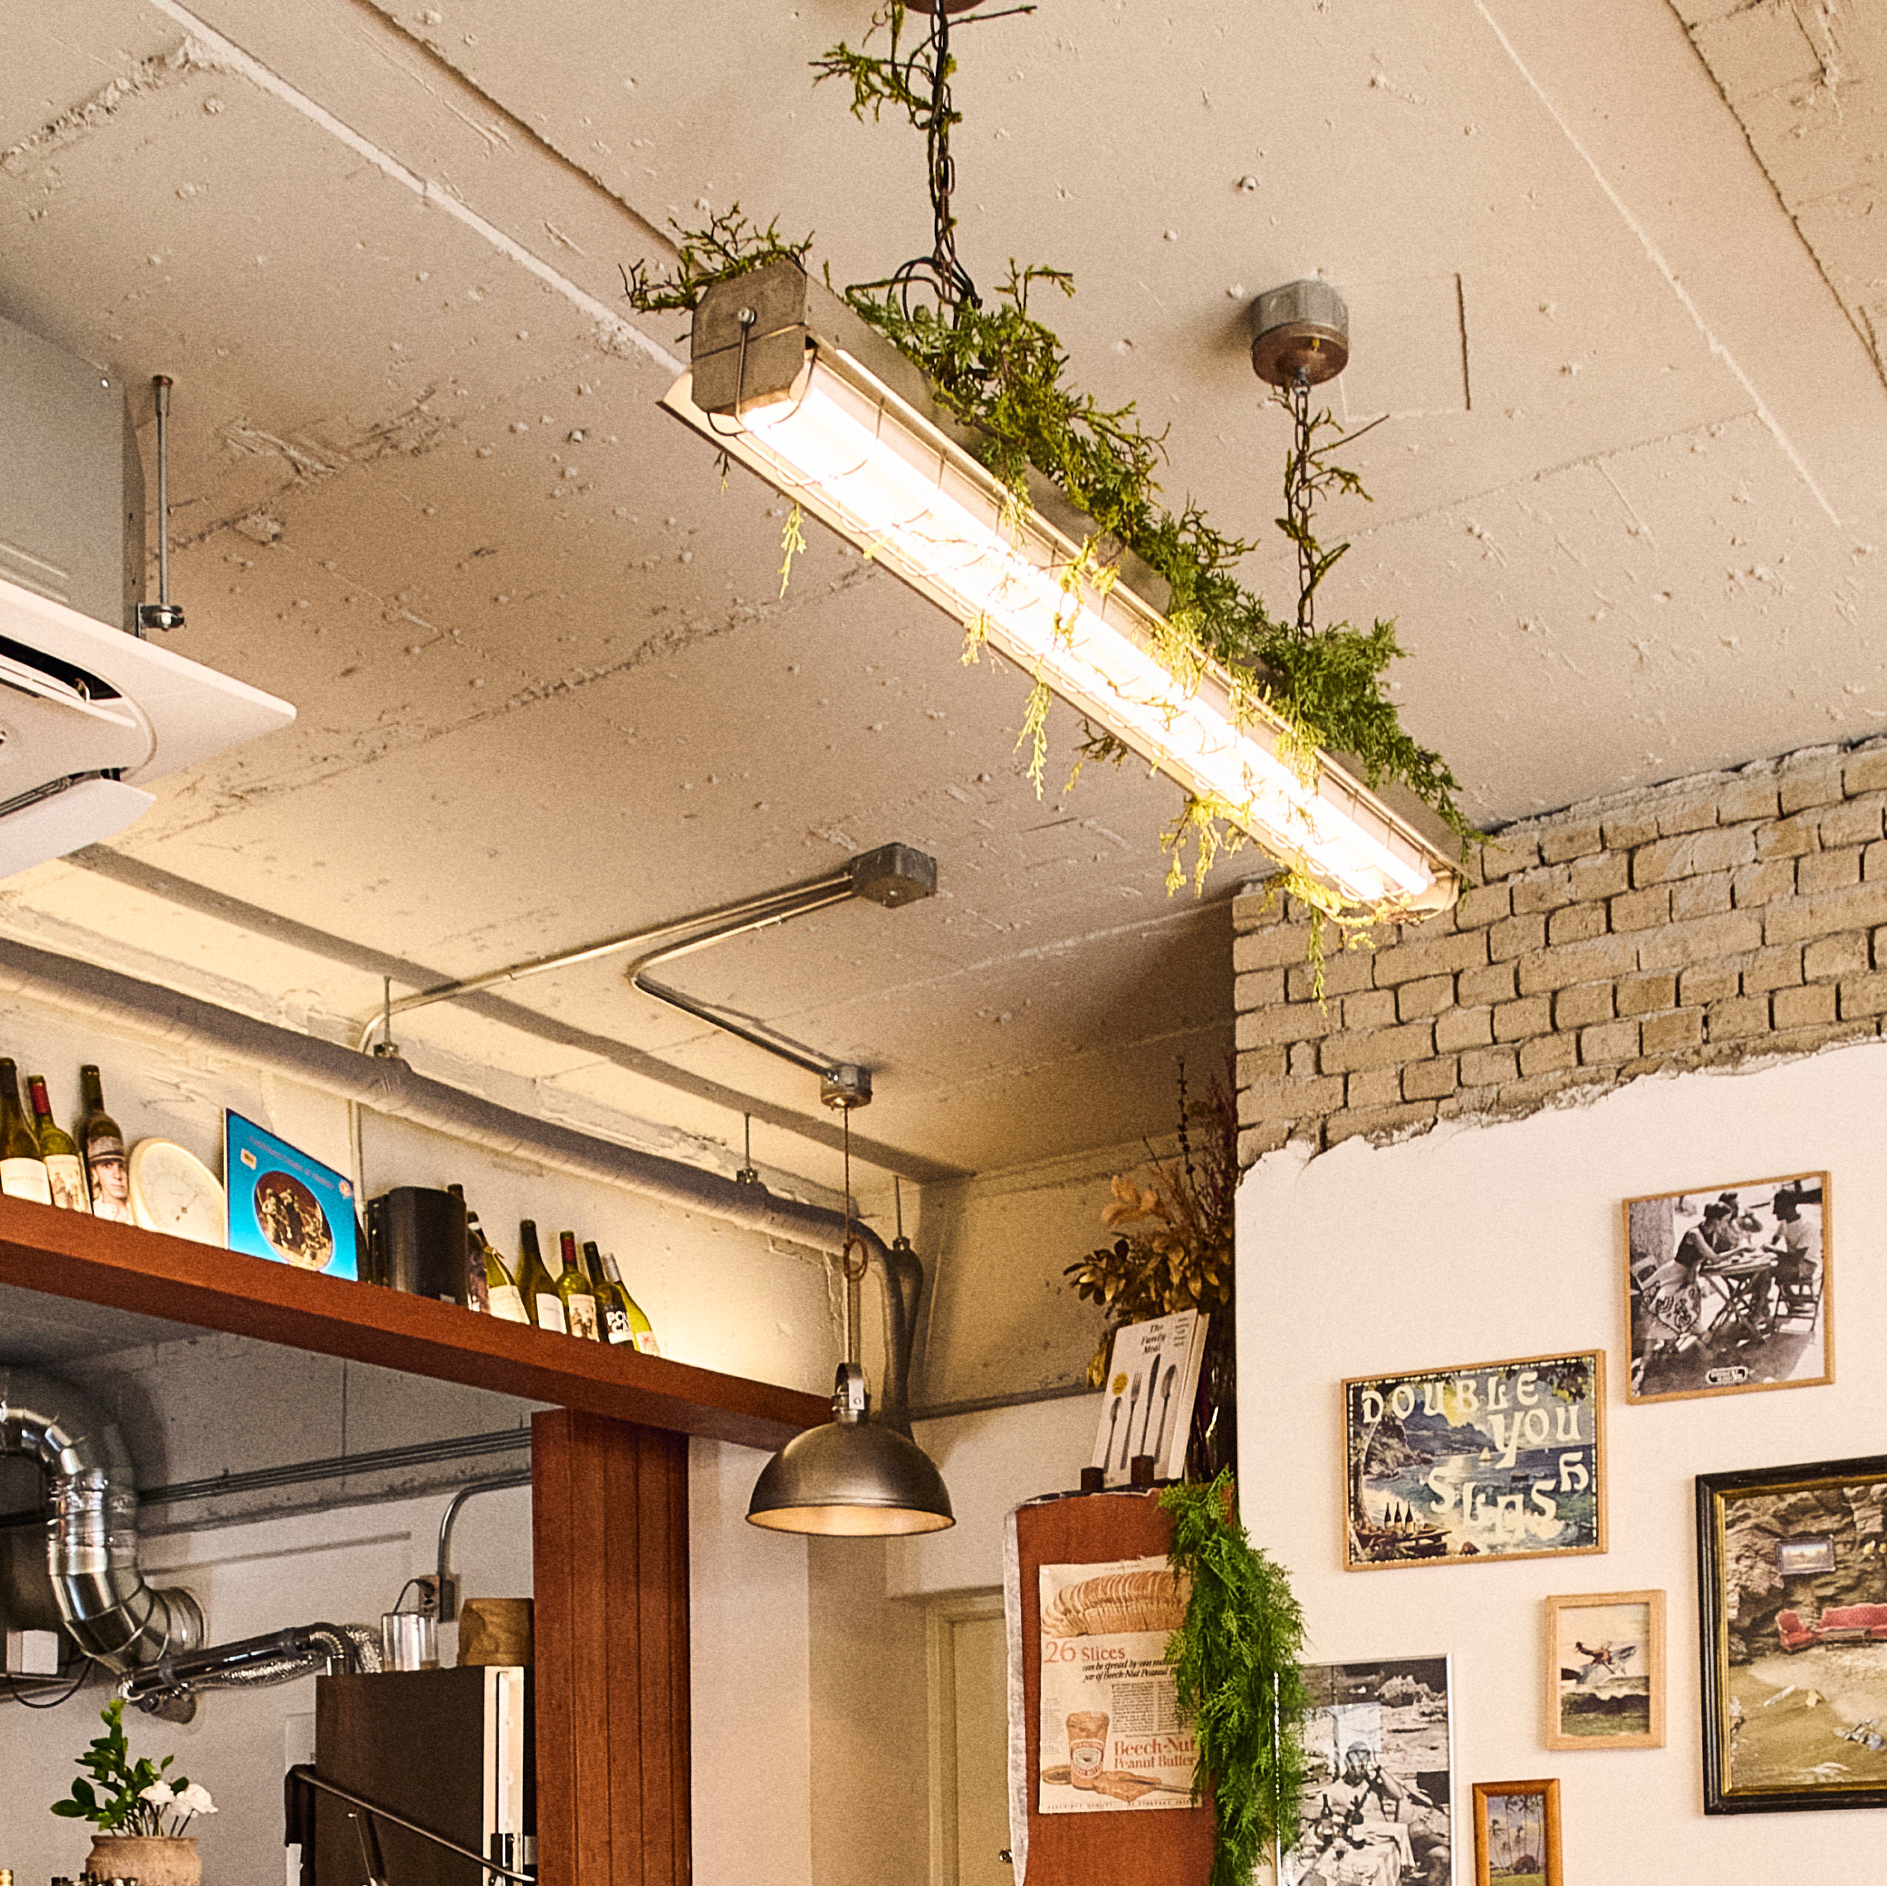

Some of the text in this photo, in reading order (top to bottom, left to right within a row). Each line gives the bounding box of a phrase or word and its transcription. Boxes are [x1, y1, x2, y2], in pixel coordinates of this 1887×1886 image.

[1361, 1371, 1539, 1424] DOUBLE
[1488, 1405, 1581, 1470] YOU
[1044, 1640, 1077, 1663] 26
[1104, 1660, 1128, 1673] spread
[1115, 1735, 1196, 1757] Beech-Nut
[1115, 1754, 1197, 1769] Peanut Butter
